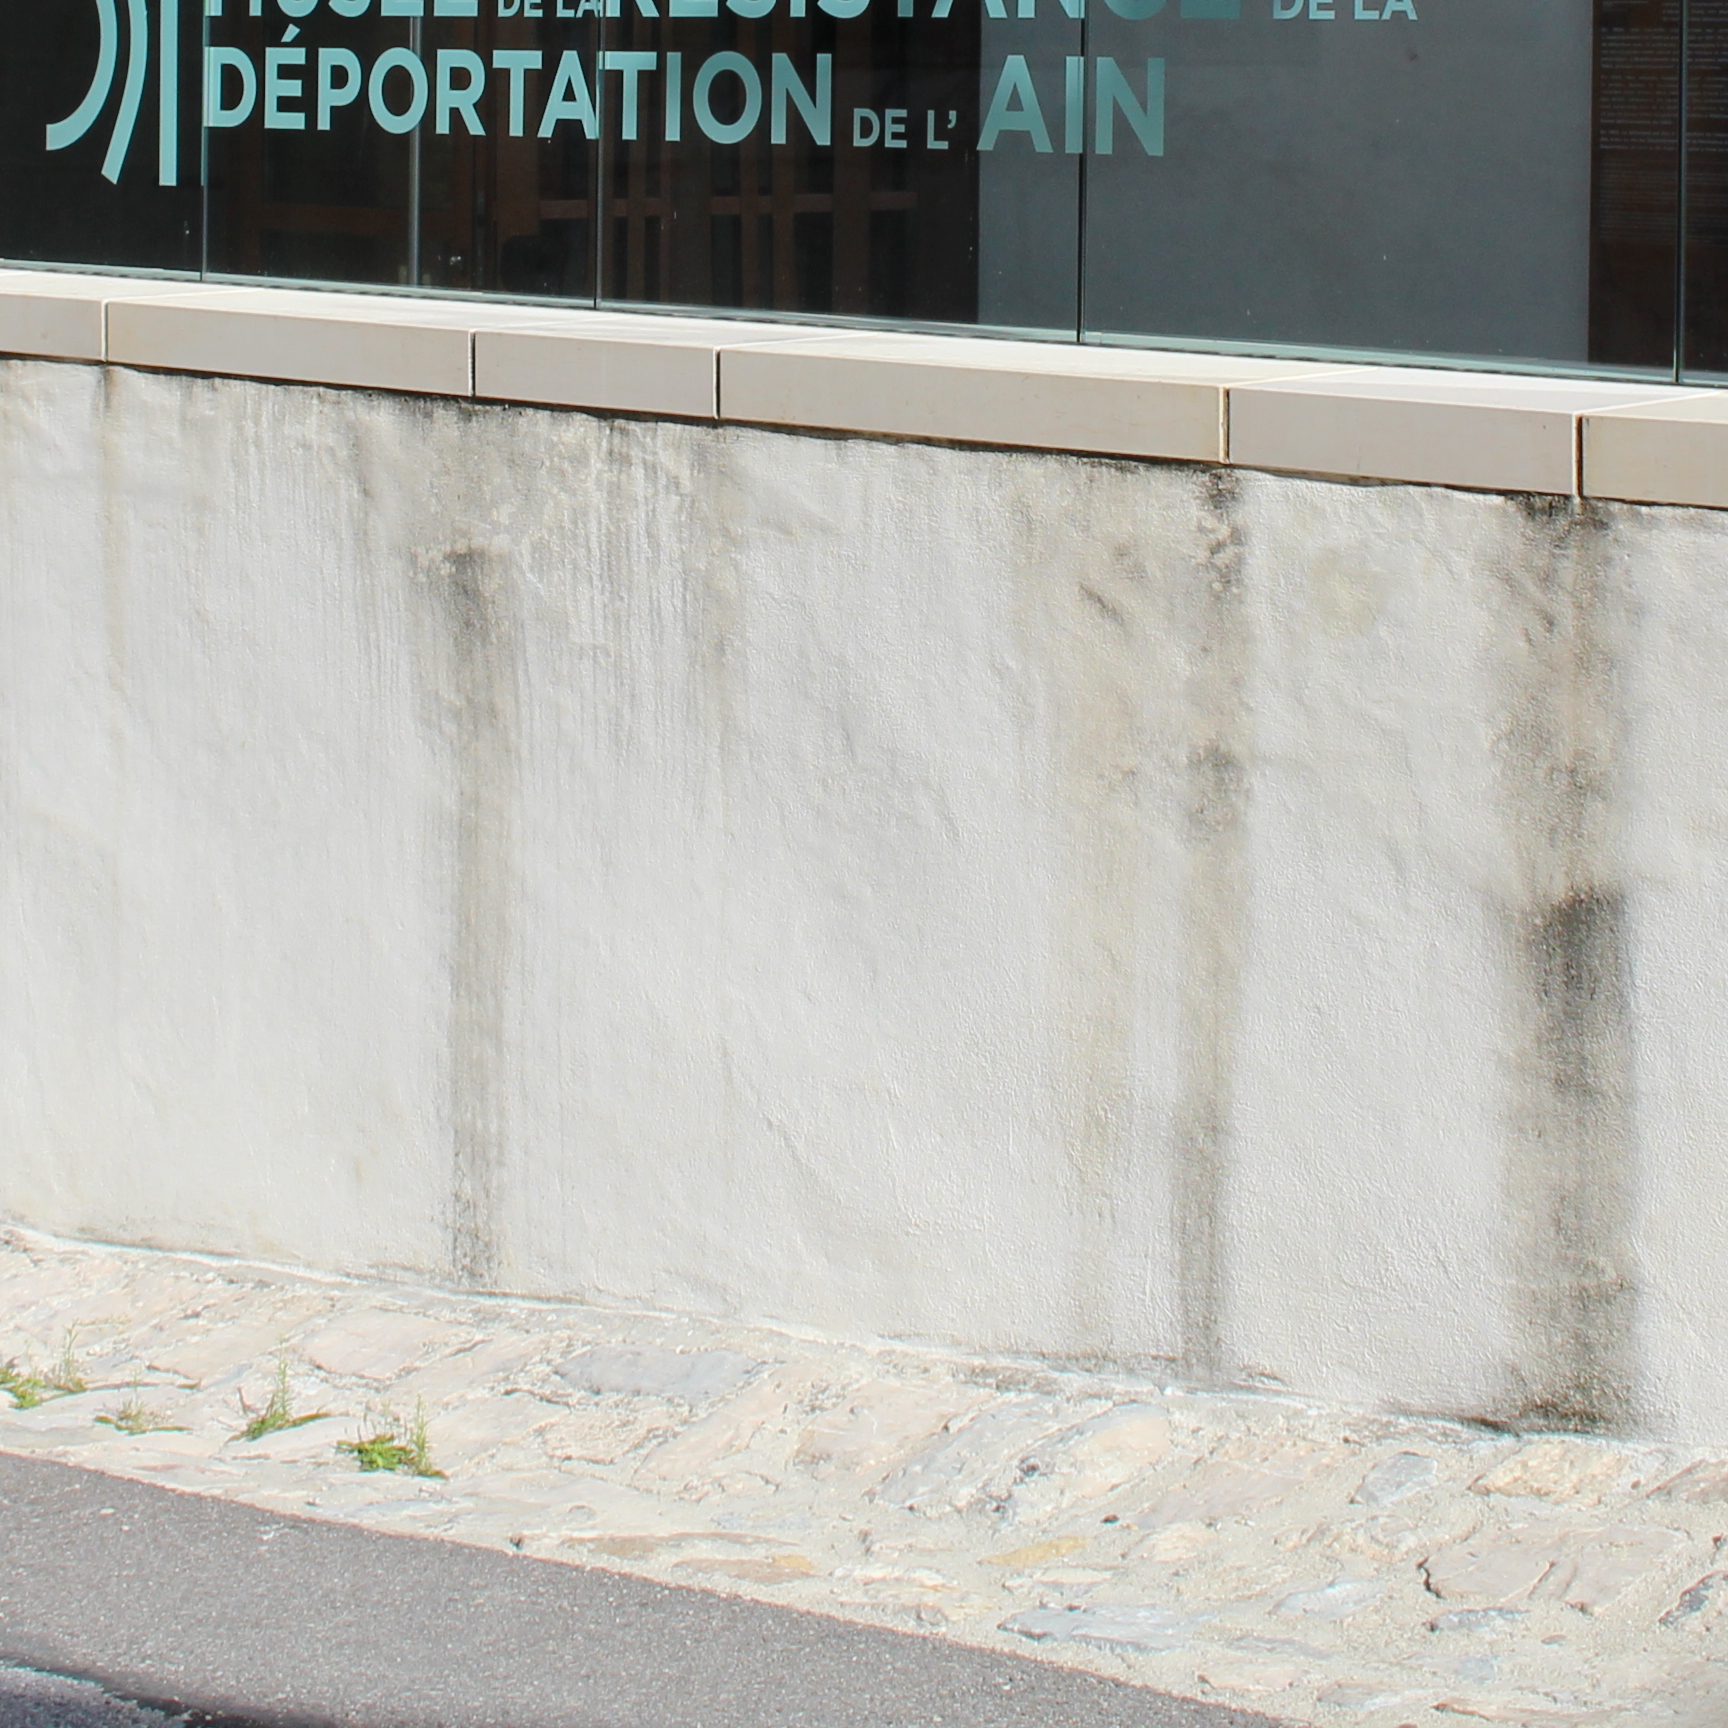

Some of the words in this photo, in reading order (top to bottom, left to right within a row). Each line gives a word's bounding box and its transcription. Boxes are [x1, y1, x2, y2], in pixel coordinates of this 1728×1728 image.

[204, 23, 832, 146] DÉPORTATION
[853, 107, 907, 149] DE
[976, 54, 1166, 156] AIN
